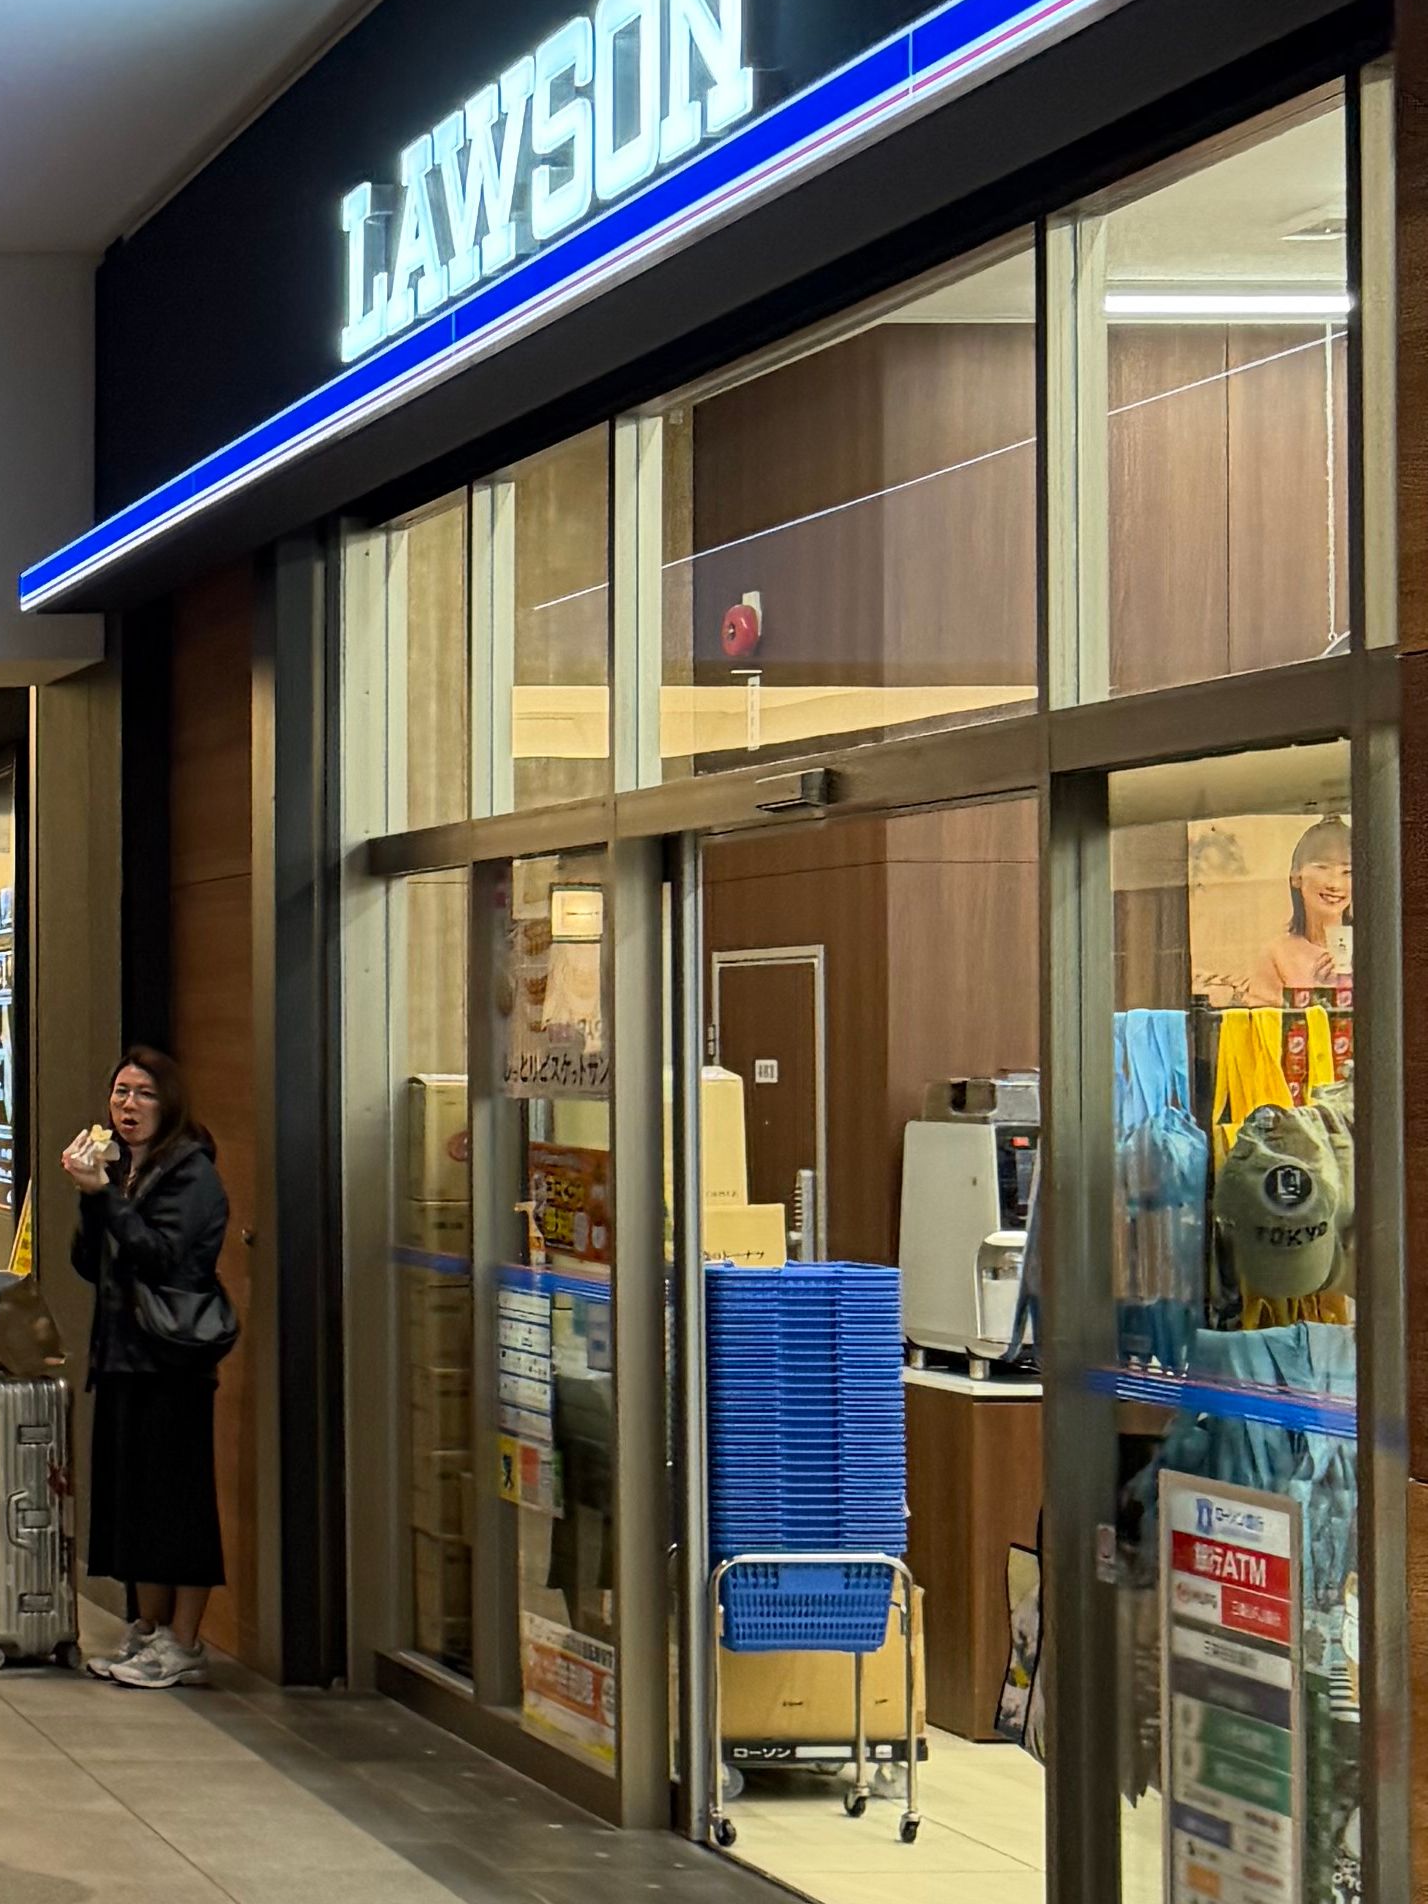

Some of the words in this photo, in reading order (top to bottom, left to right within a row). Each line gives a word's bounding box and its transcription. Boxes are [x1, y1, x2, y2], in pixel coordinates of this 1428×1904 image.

[1255, 1220, 1328, 1248] TOKYO
[733, 1747, 791, 1759] ローソン
